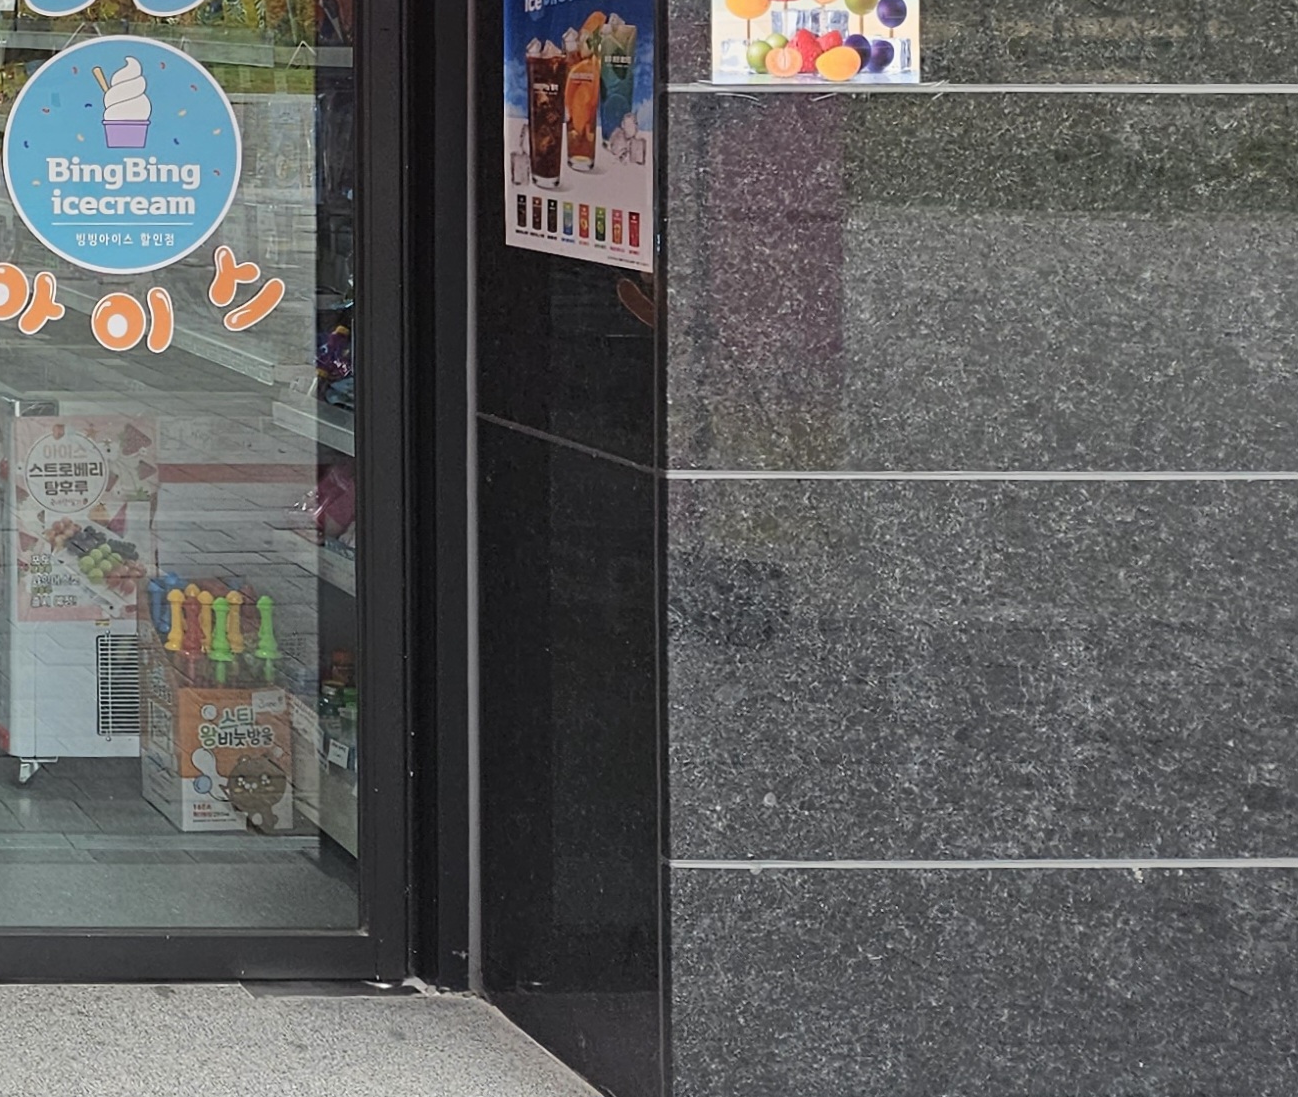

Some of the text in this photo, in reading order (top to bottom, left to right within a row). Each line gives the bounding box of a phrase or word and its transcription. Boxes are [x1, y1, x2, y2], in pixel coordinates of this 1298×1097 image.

[46, 157, 200, 190] BingBing
[51, 189, 196, 215] icecream
[75, 232, 175, 247] 빙빙아이스 할인점
[29, 462, 104, 478] 스트로베리
[44, 480, 89, 496] 탕후루
[199, 723, 274, 748] 왕비눗방울
